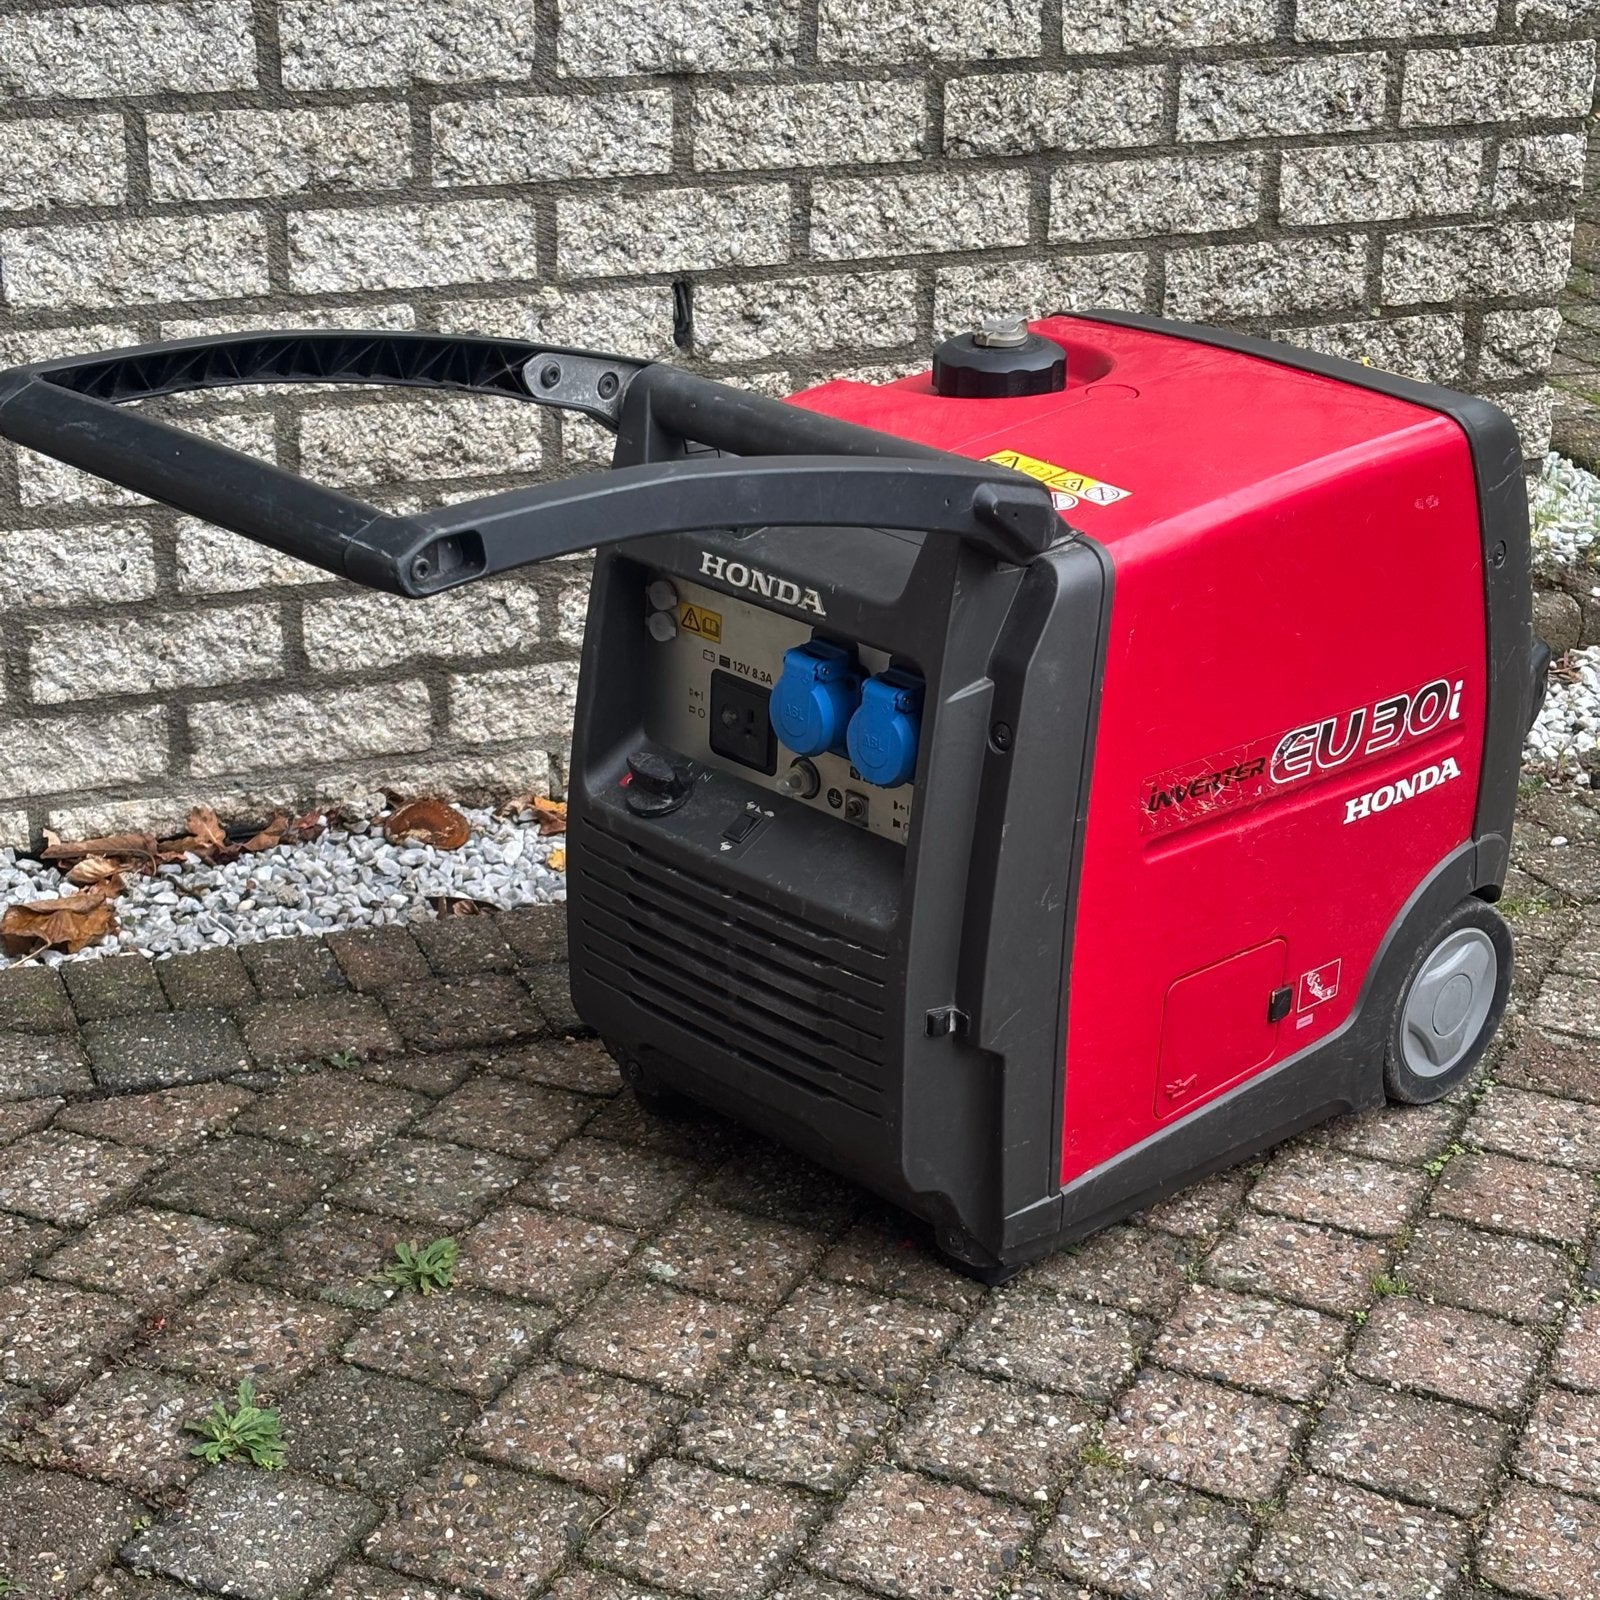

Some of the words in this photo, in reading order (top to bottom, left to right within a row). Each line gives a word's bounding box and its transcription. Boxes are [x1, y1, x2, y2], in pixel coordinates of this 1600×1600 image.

[699, 551, 827, 616] HONDA
[733, 661, 750, 675] 12V
[752, 668, 773, 685] 8.3A
[1270, 679, 1464, 784] EU30i
[1343, 757, 1460, 824] HONDA
